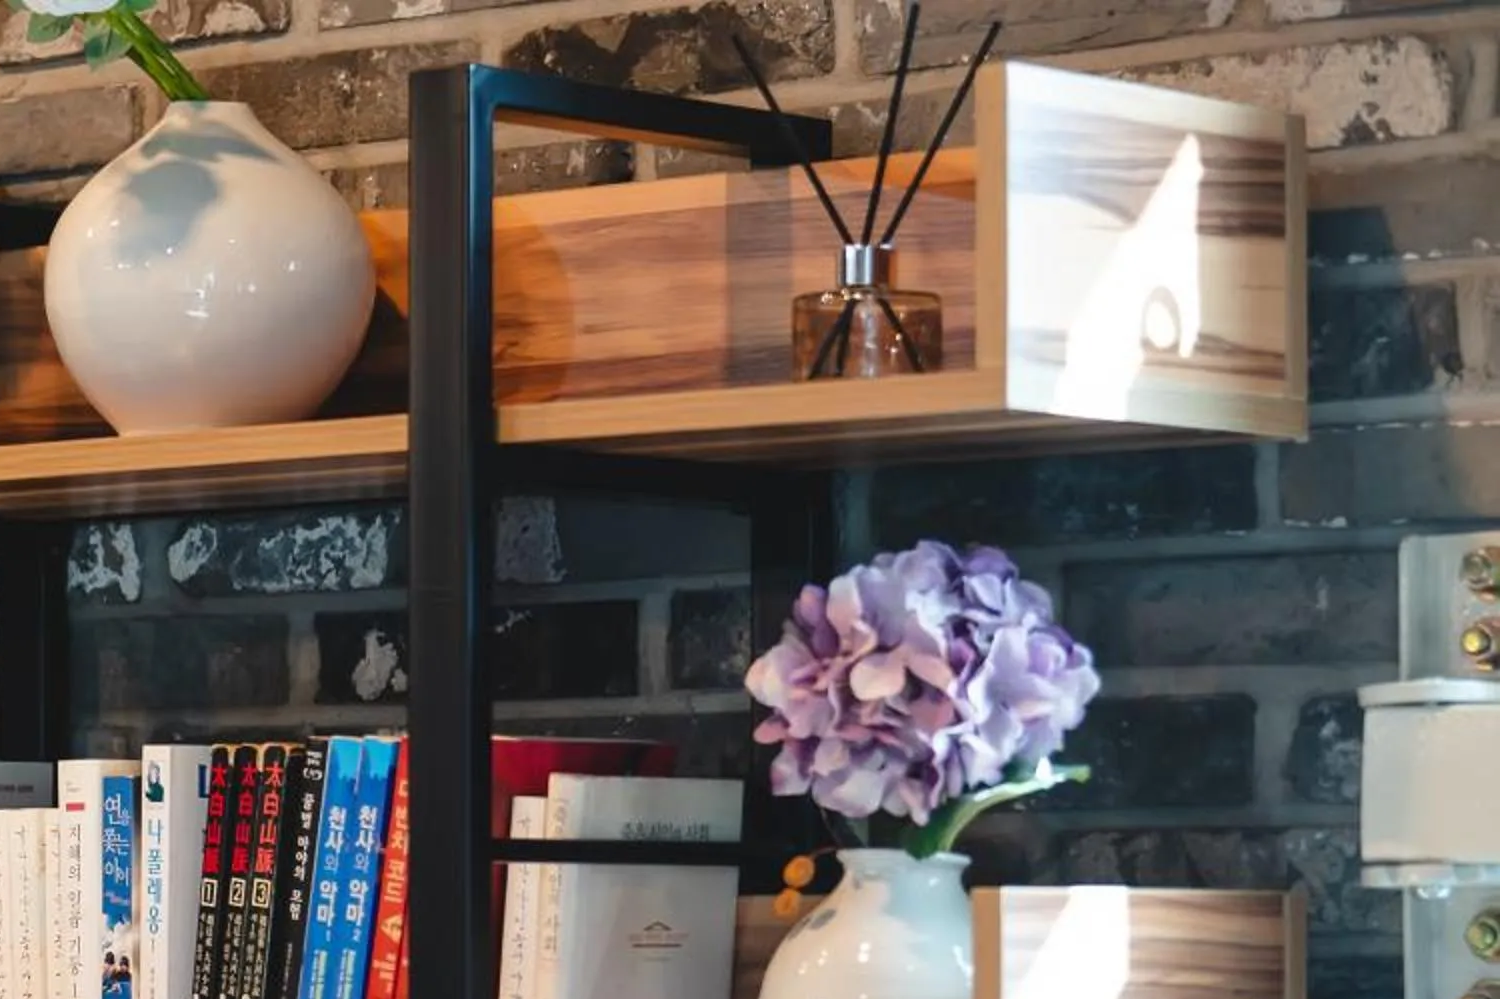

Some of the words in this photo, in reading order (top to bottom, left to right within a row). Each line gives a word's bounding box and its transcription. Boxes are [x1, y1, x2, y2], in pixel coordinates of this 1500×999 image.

[323, 805, 347, 874] 천사와
[353, 804, 378, 874] 천사와
[147, 818, 164, 934] 나폴레옹
[316, 879, 339, 928] 악마
[346, 878, 369, 928] 악마
